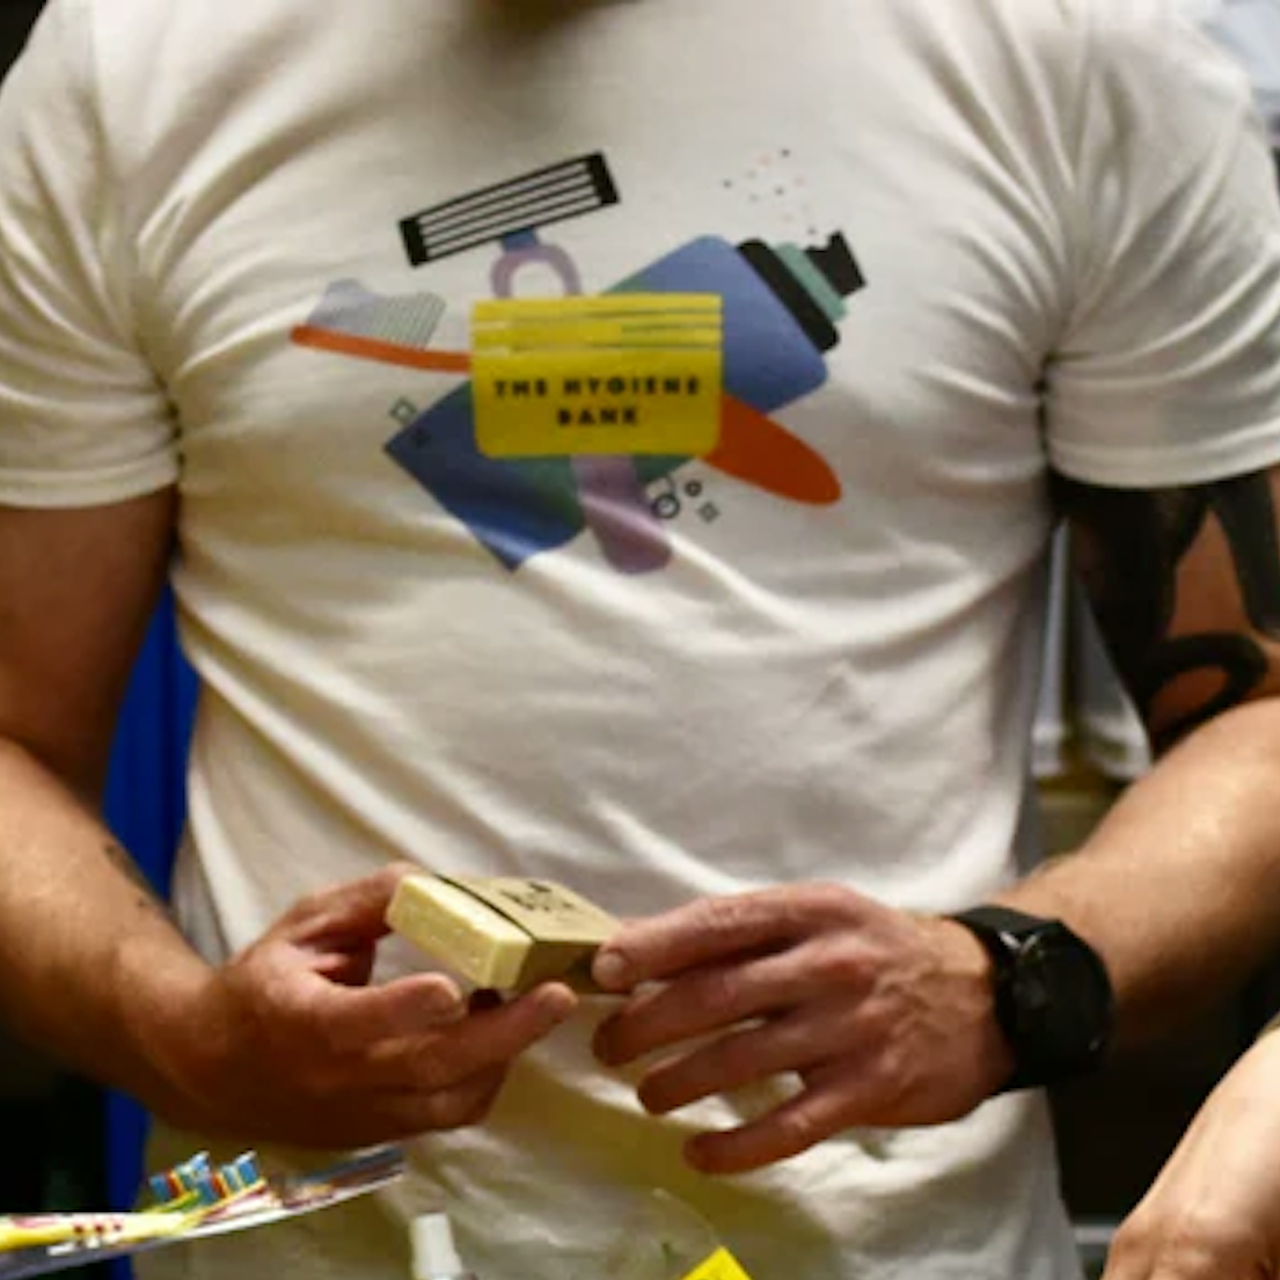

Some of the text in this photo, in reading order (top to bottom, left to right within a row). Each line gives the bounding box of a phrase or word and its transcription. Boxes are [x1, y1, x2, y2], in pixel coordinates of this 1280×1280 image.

[494, 376, 700, 397] THE HYGIENE
[557, 407, 639, 427] BANK
